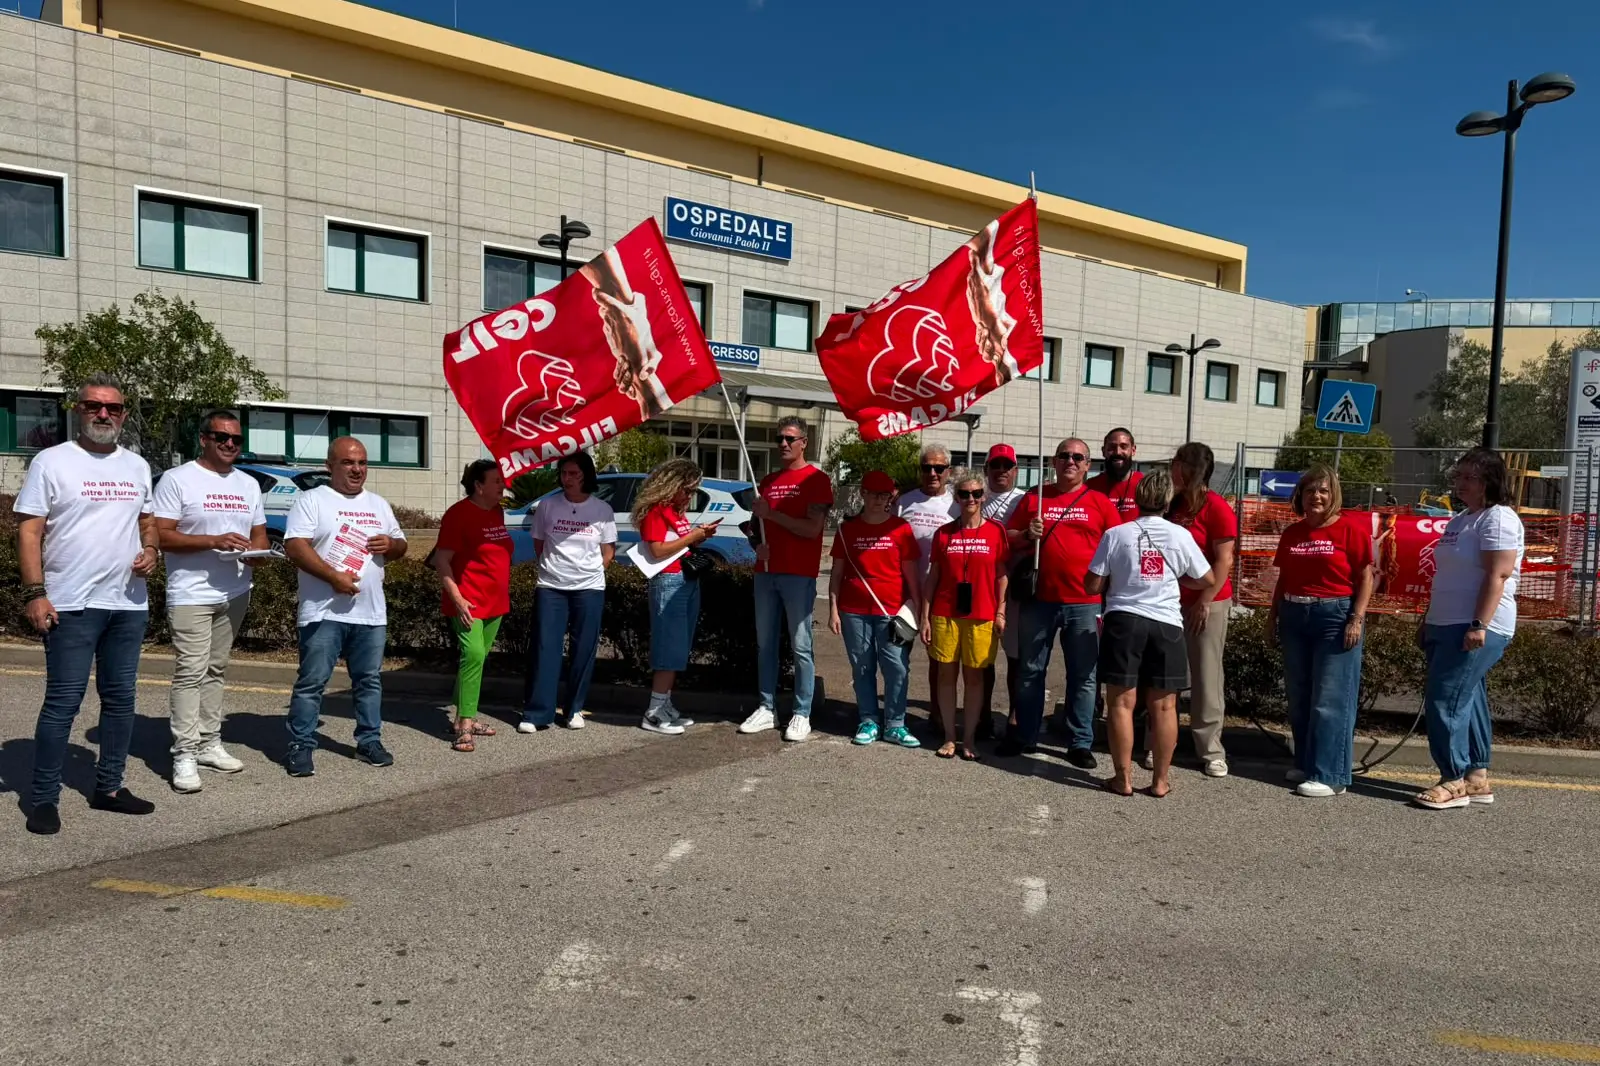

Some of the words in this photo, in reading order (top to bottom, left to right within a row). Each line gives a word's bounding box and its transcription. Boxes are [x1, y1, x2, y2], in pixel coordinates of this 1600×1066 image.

[673, 203, 787, 242] OSPEDALE
[690, 226, 733, 245] Giovanni
[734, 235, 760, 249] Paolo
[762, 241, 771, 251] II
[708, 345, 758, 361] GRESSO
[206, 494, 245, 502] PERSONE
[225, 503, 250, 511] MERCI
[708, 502, 735, 512] 113
[557, 519, 591, 527] PERSONE
[1296, 539, 1333, 547] PERSONE
[1405, 584, 1432, 594] FIL
